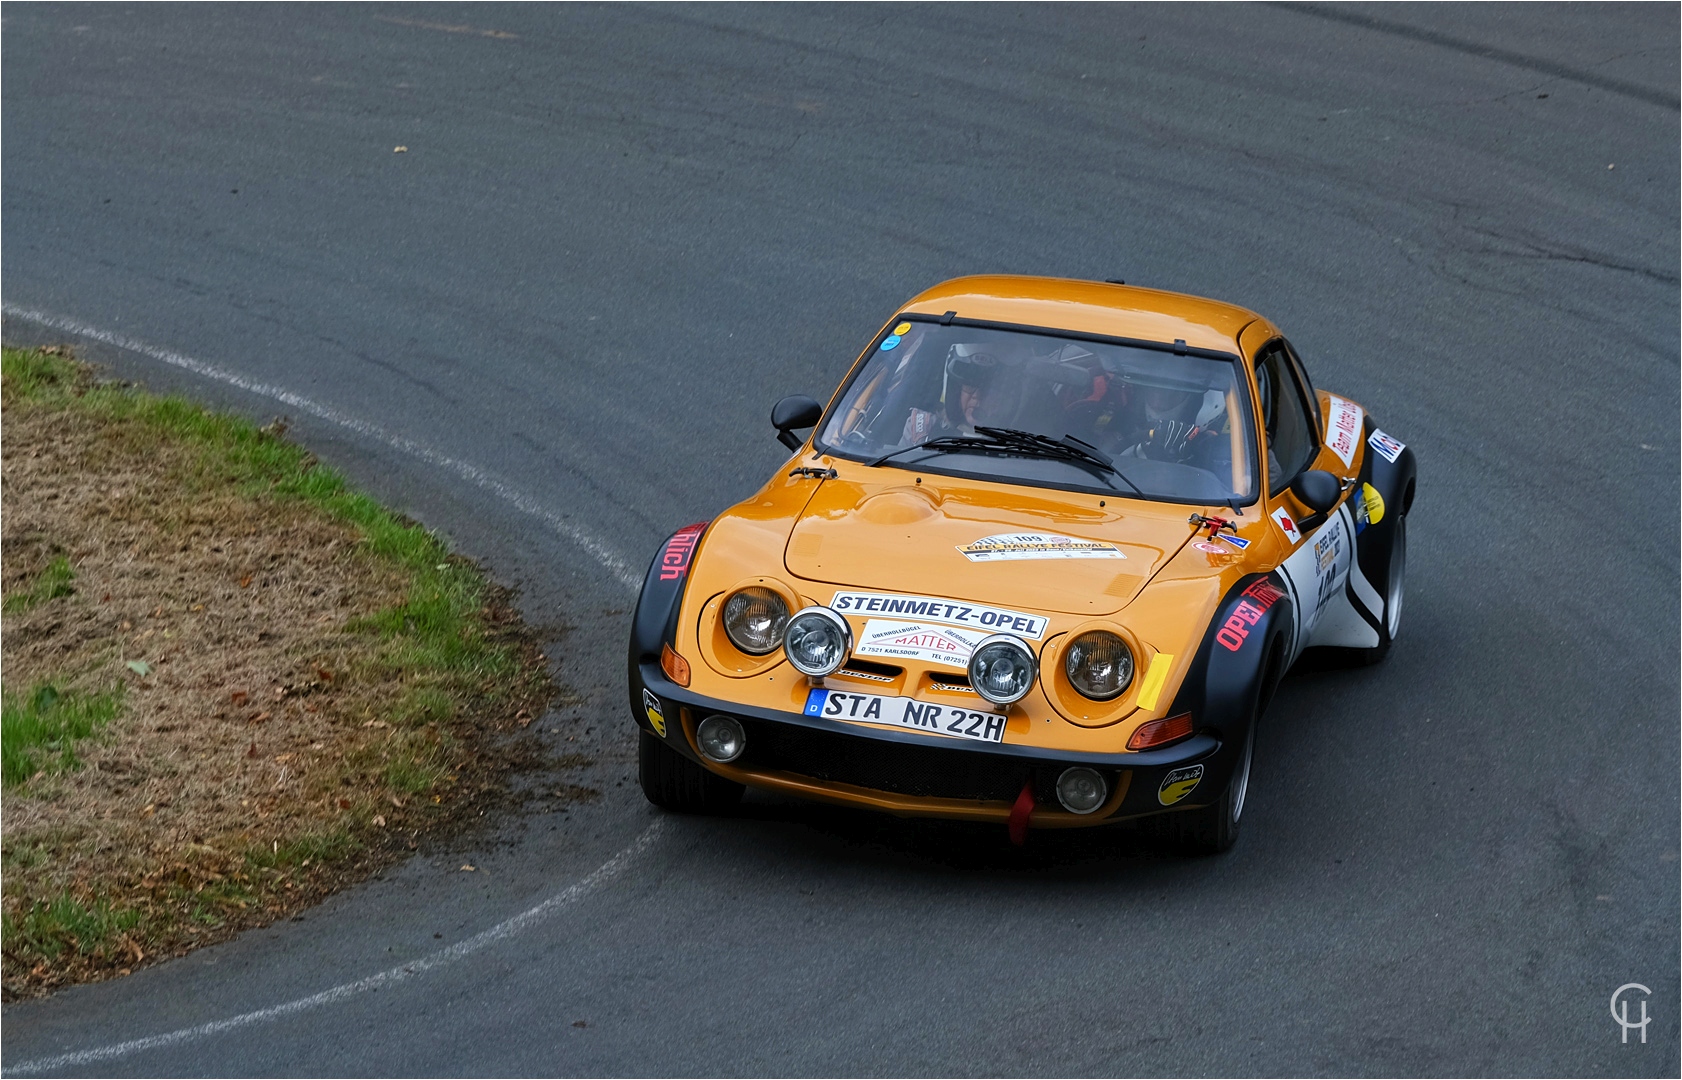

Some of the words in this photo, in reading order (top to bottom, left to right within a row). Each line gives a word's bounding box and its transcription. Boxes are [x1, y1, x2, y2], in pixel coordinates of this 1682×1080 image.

[836, 596, 1039, 635] STEINMETZ-OPEL
[871, 626, 921, 639] ÜBERROLLBÜGEL
[1216, 600, 1267, 652] OPEL
[884, 648, 920, 656] KARLSDORF
[894, 635, 957, 652] MATTER
[810, 705, 816, 713] D
[825, 693, 882, 719] STA
[902, 701, 942, 728] NR
[947, 710, 1005, 741] 22H
